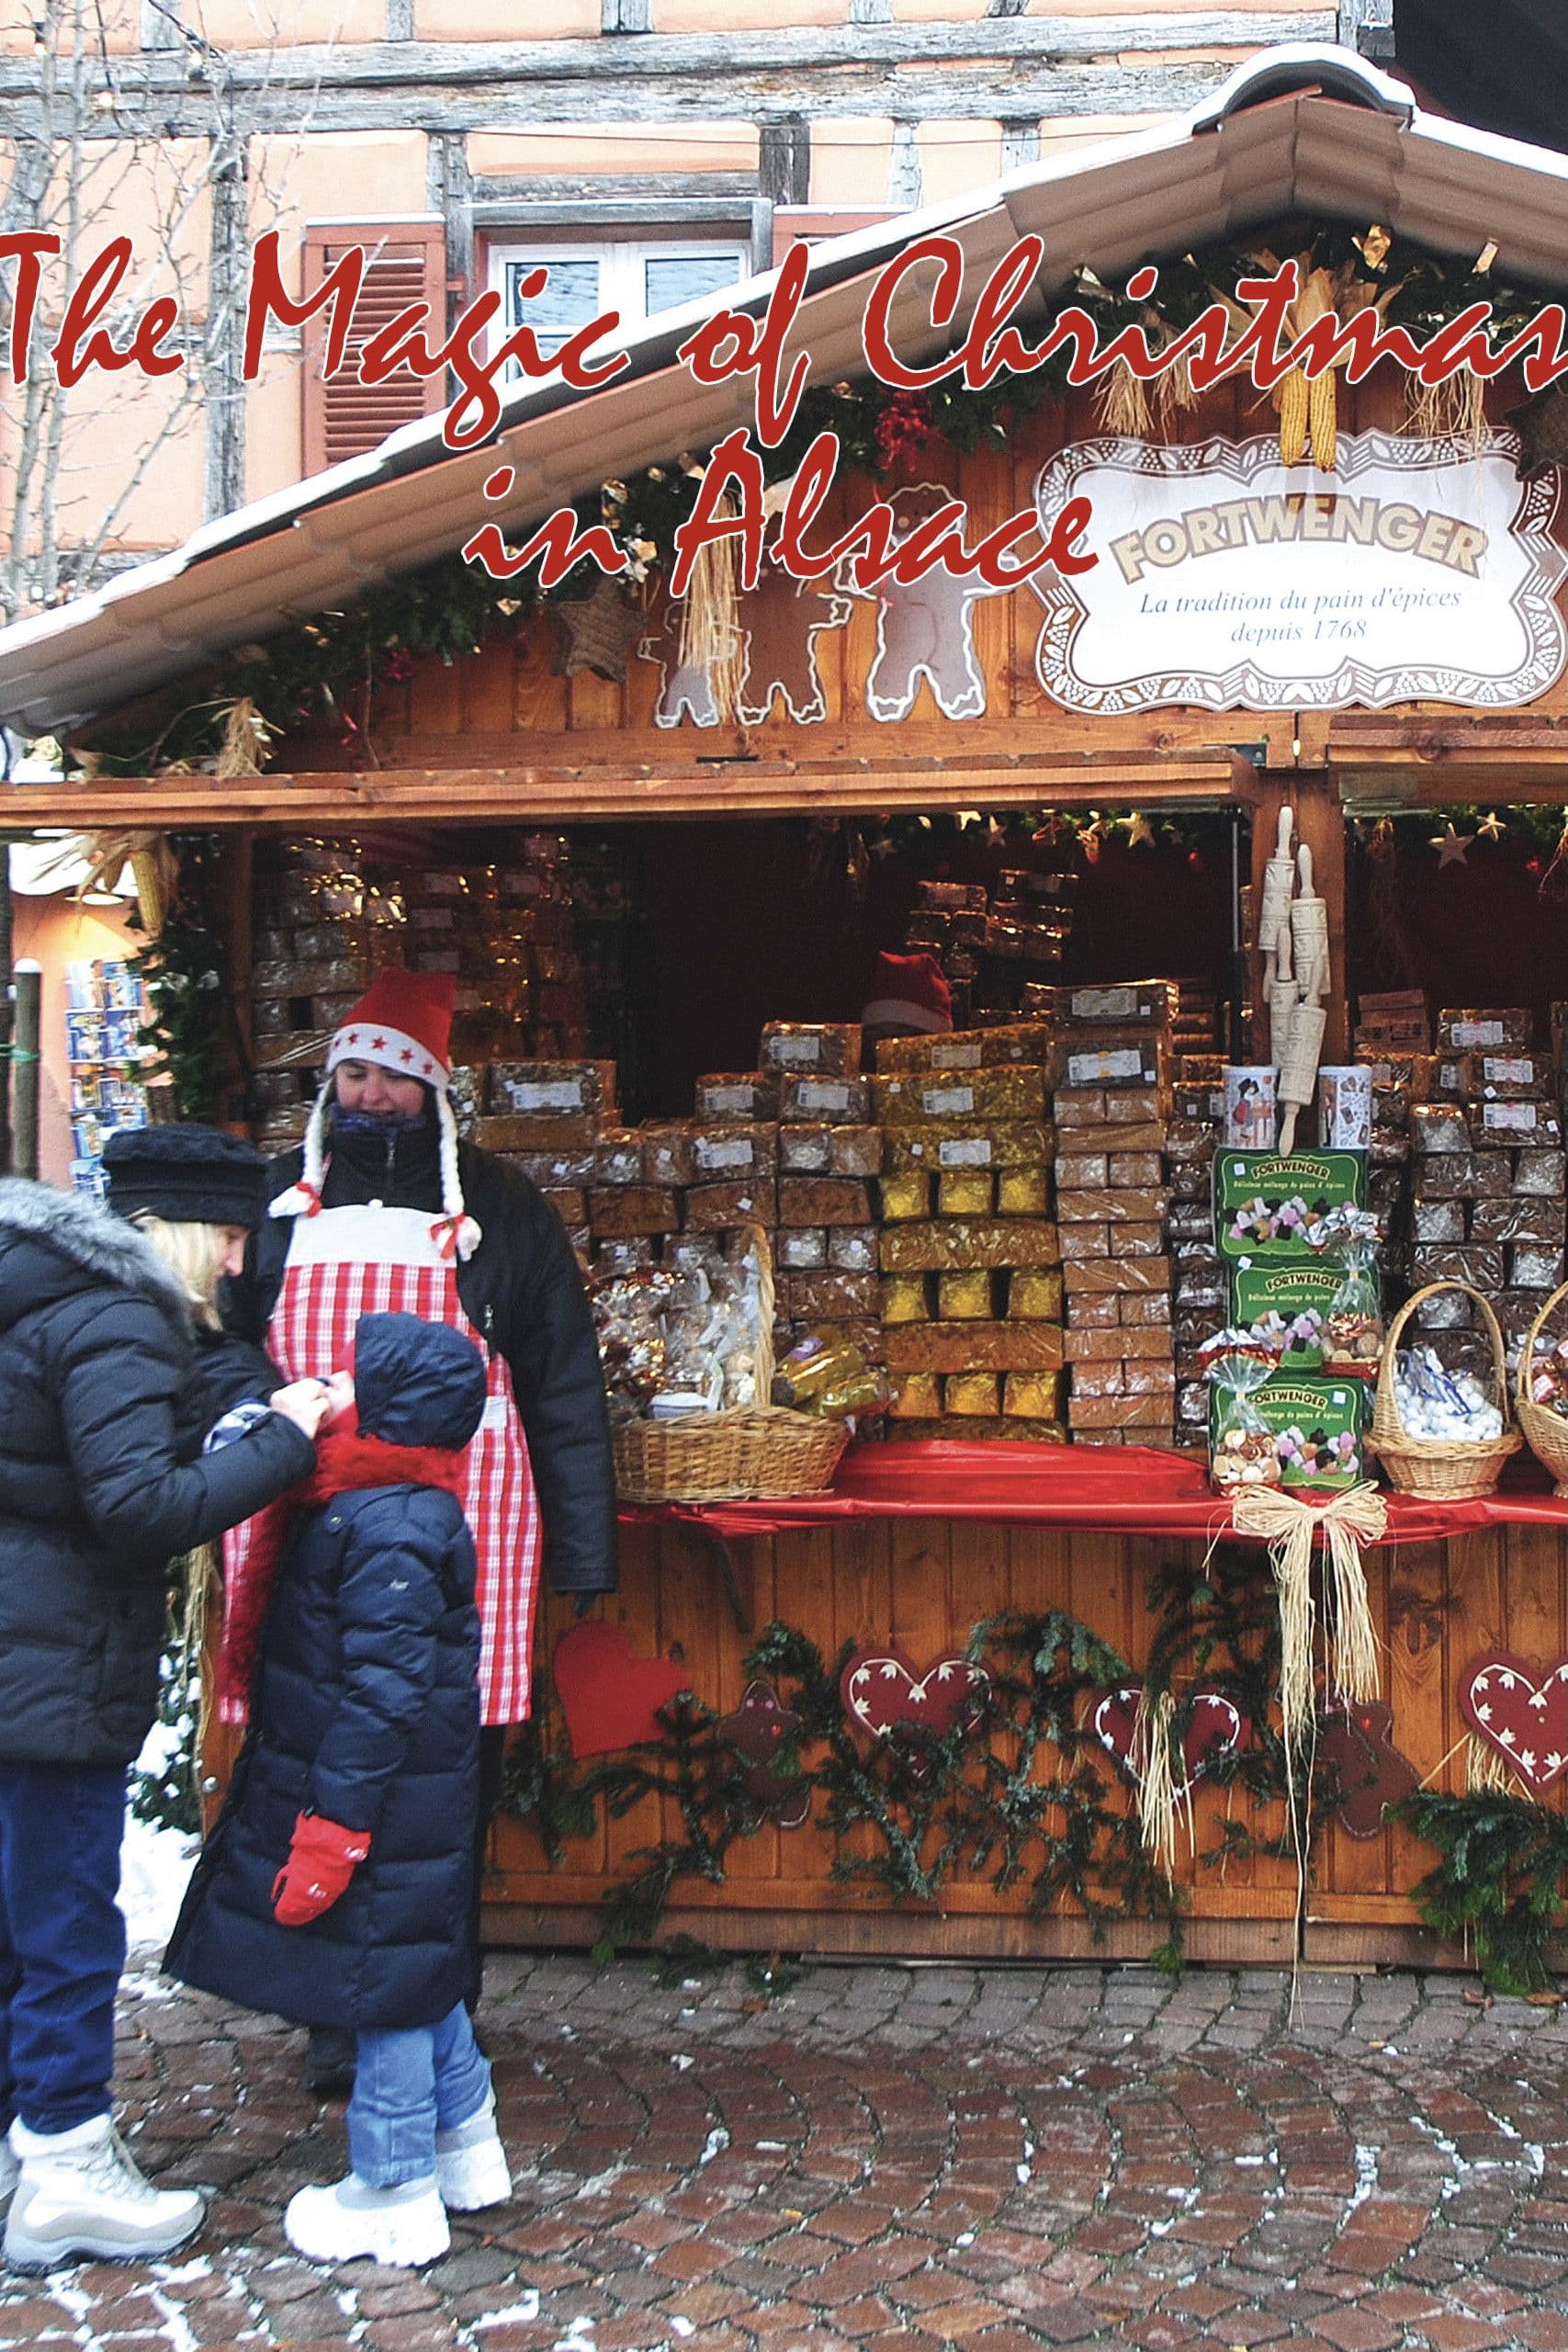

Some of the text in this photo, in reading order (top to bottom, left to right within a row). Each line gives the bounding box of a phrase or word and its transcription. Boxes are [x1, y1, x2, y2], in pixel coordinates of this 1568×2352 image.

[1109, 492, 1488, 584] FORTWENGER
[1139, 587, 1462, 614] La tradition du pain d'épices
[1230, 619, 1367, 647] depuis 1768
[1251, 1159, 1330, 1180] FORTWENGER
